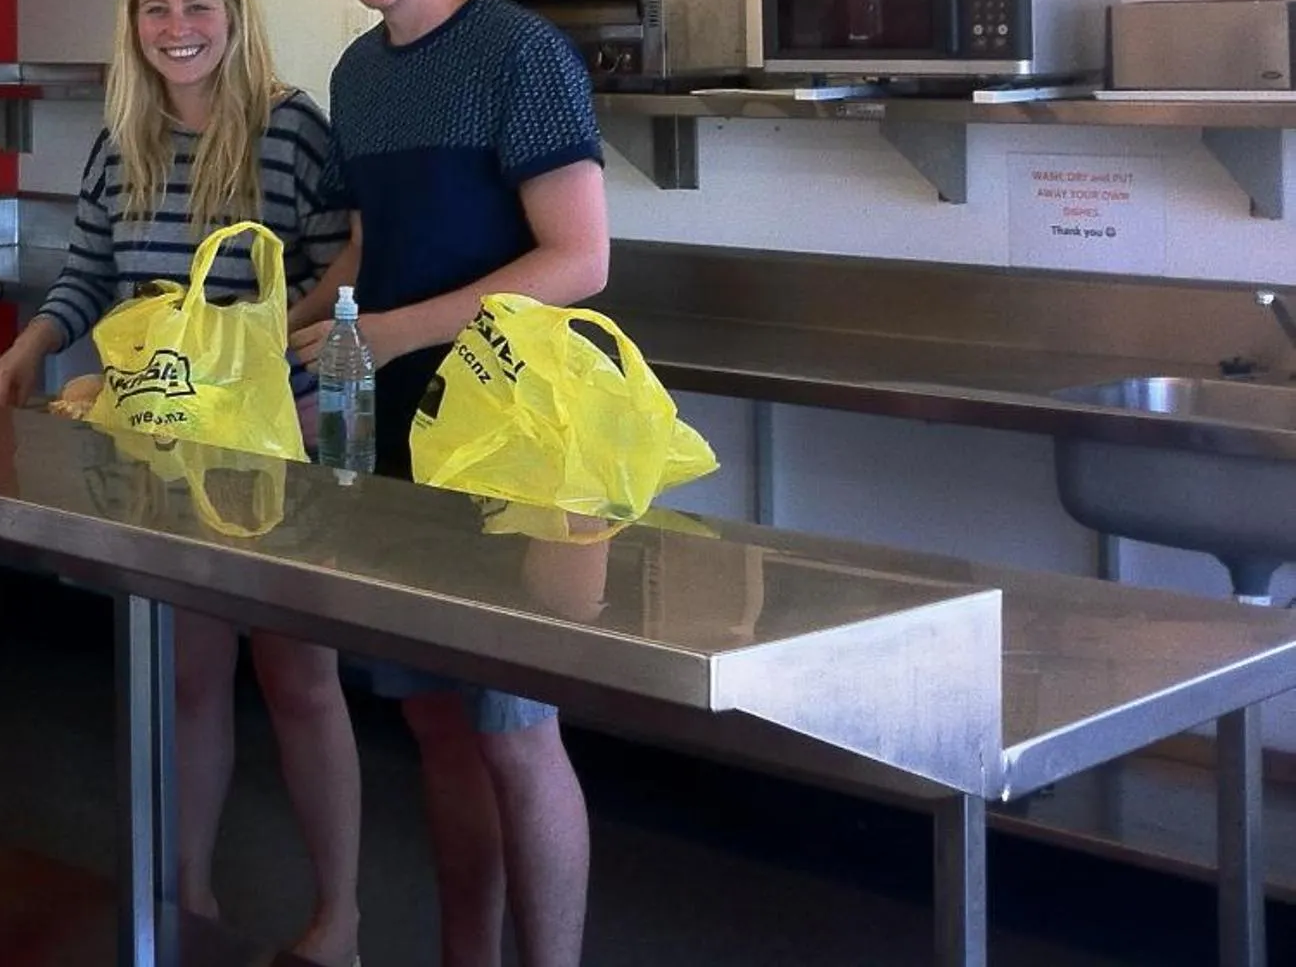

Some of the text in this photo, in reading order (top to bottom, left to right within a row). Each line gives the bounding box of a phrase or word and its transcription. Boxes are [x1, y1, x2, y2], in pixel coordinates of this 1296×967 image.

[1112, 173, 1134, 183] PUT
[1037, 188, 1068, 199] AWAY
[1070, 190, 1098, 200] YOUR
[1051, 225, 1103, 238] Thank you
